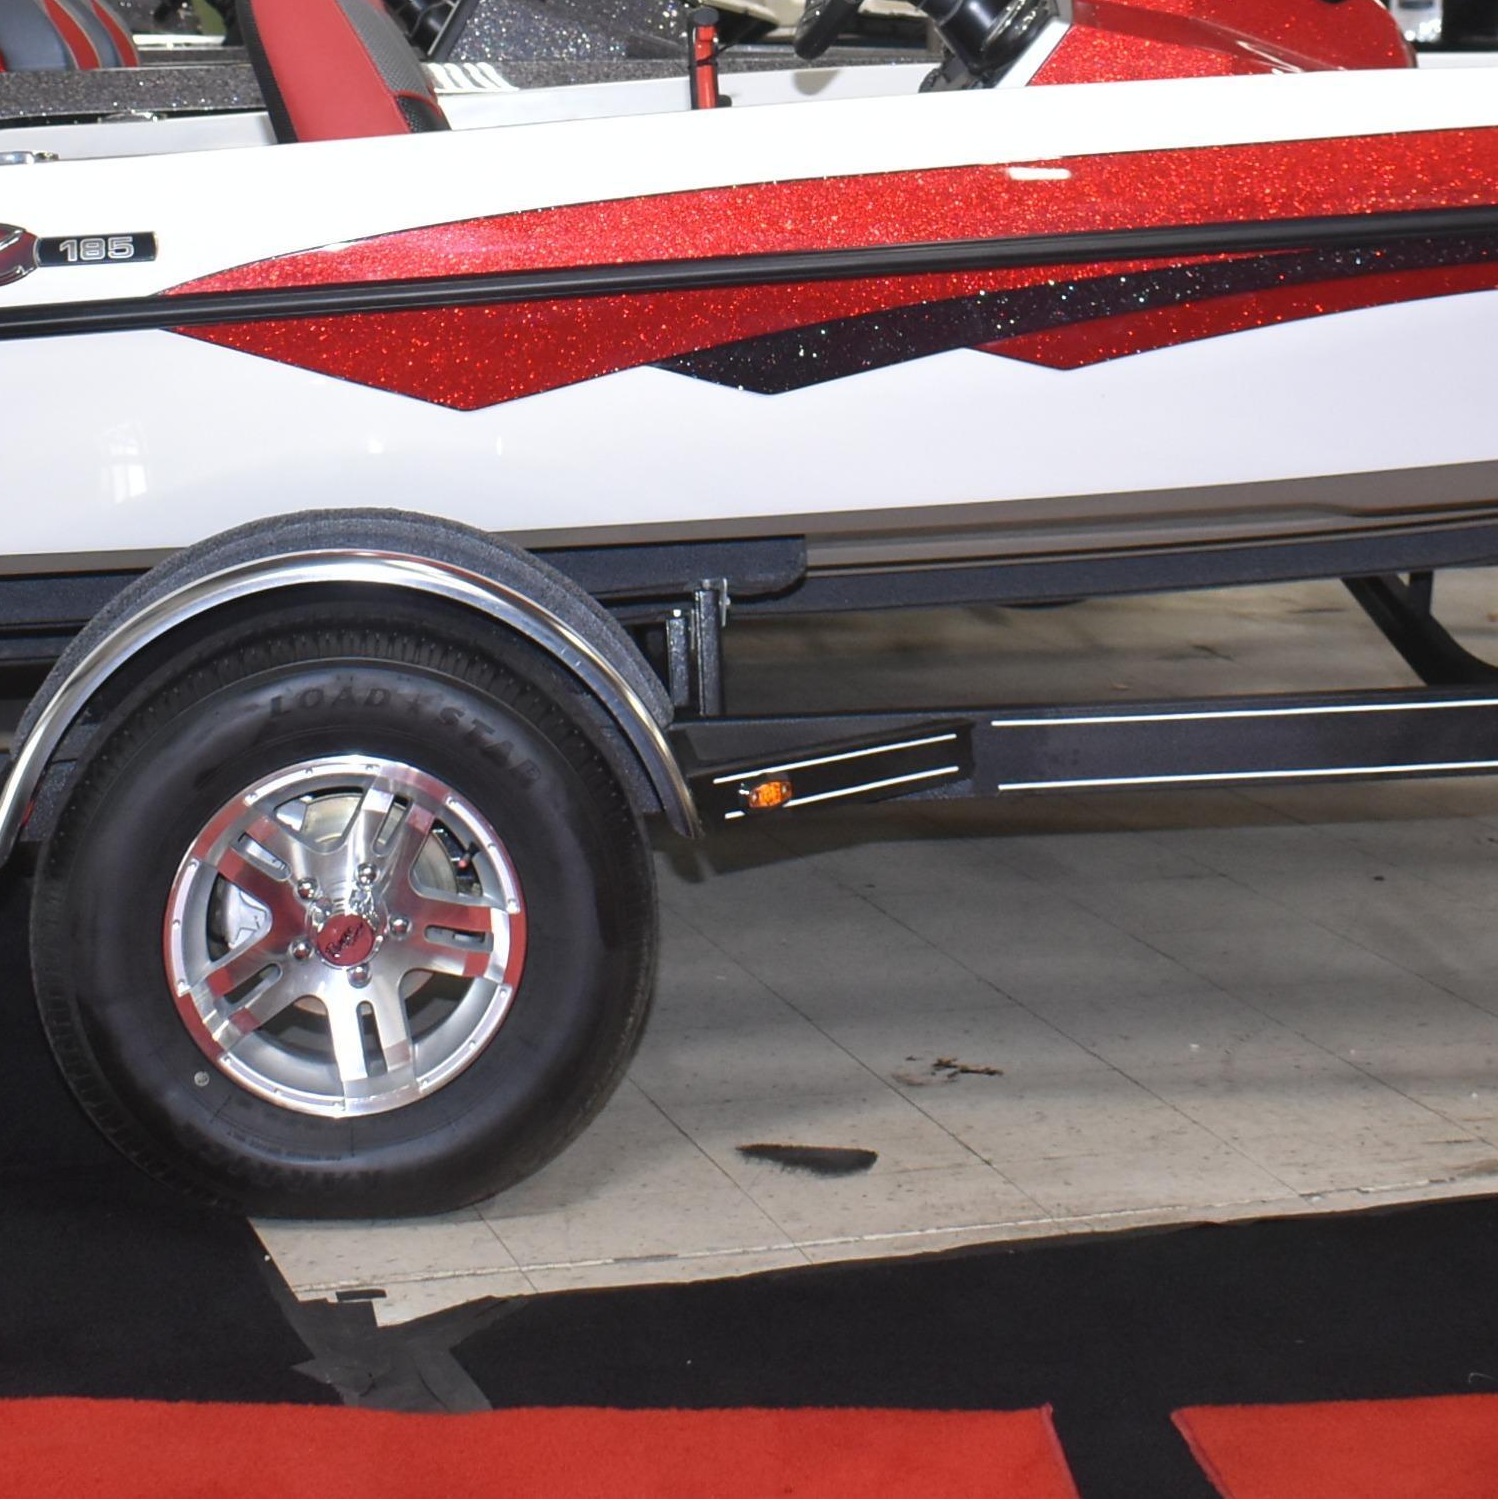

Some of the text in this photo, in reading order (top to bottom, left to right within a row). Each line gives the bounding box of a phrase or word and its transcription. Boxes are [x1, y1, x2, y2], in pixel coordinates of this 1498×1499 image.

[58, 235, 136, 264] 185
[269, 686, 542, 788] LOAD STAR
